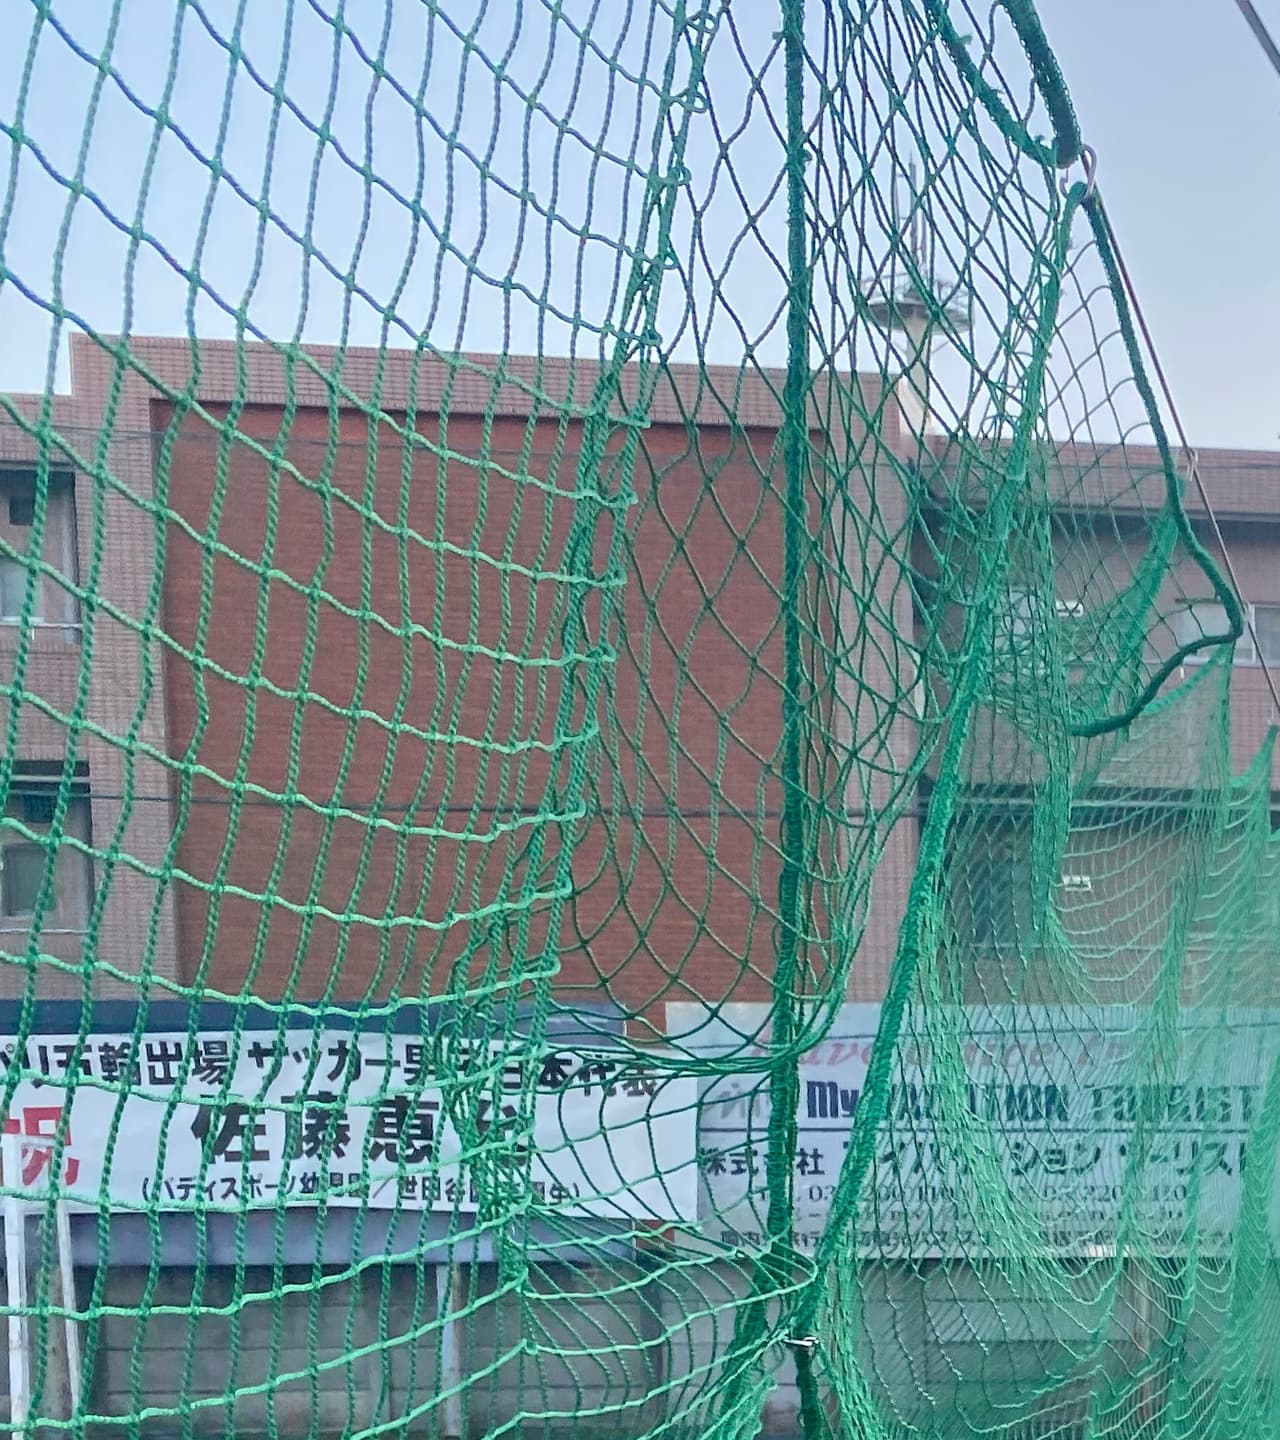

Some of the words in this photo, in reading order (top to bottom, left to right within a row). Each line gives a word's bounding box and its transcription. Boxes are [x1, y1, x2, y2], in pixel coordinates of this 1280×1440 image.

[248, 1040, 659, 1097] サッカー男日本代表
[699, 1147, 825, 1176] 株式社
